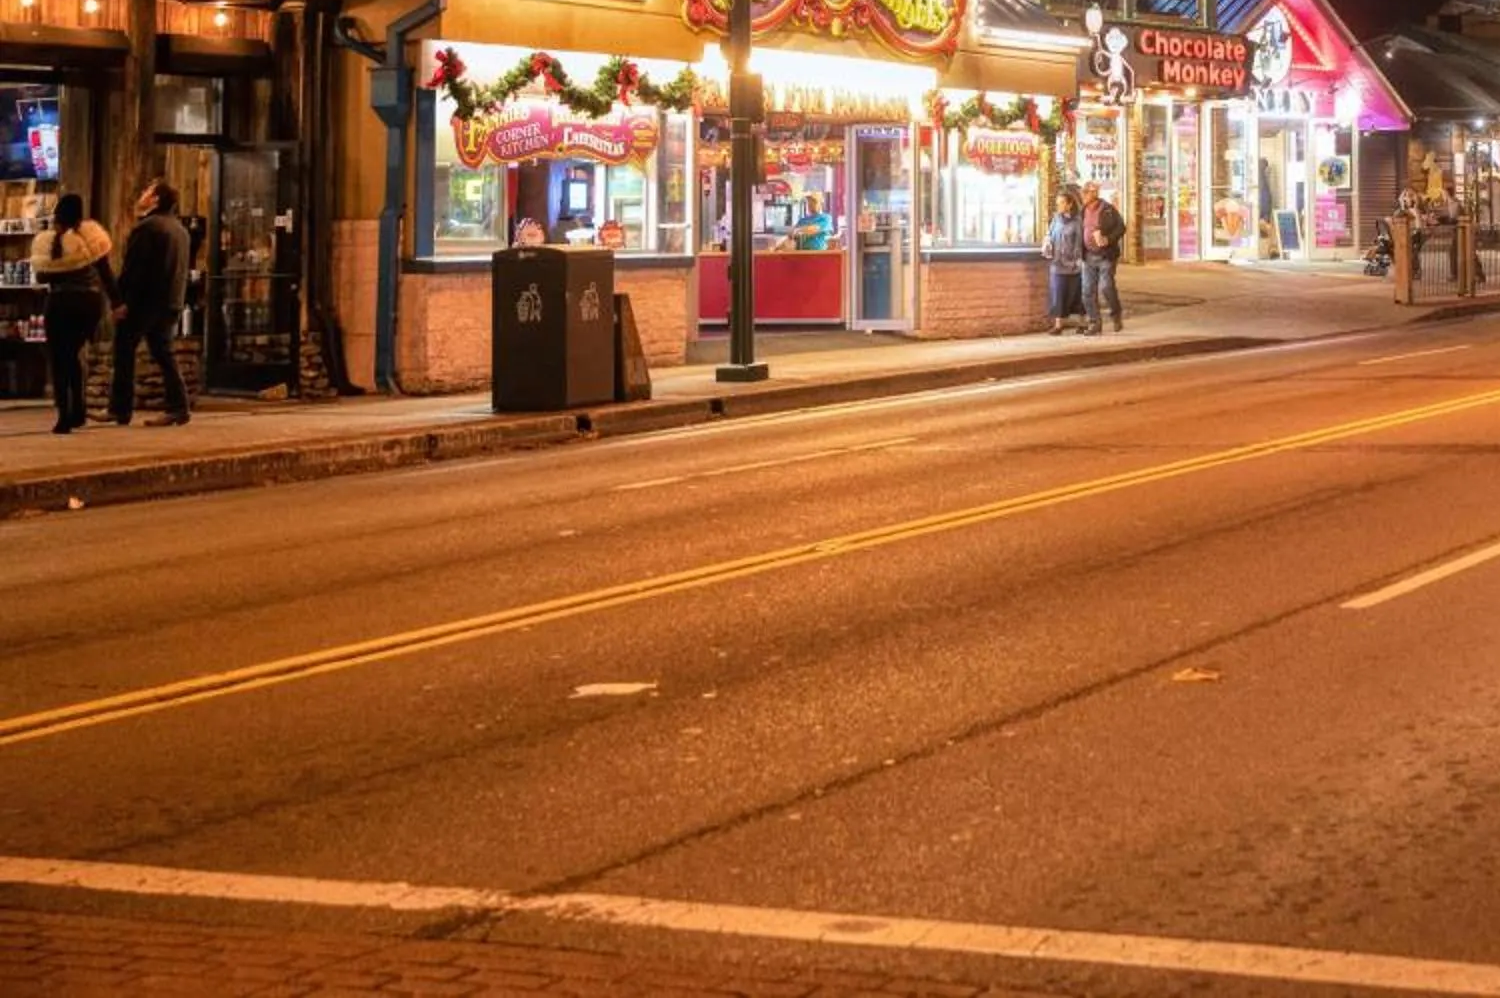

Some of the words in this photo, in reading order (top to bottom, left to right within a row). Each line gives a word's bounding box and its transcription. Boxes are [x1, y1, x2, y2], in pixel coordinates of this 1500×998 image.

[1140, 28, 1247, 62] Chocolate
[1163, 58, 1246, 90] Monkey
[495, 121, 541, 145] CORNER
[501, 133, 549, 157] KITCHEN
